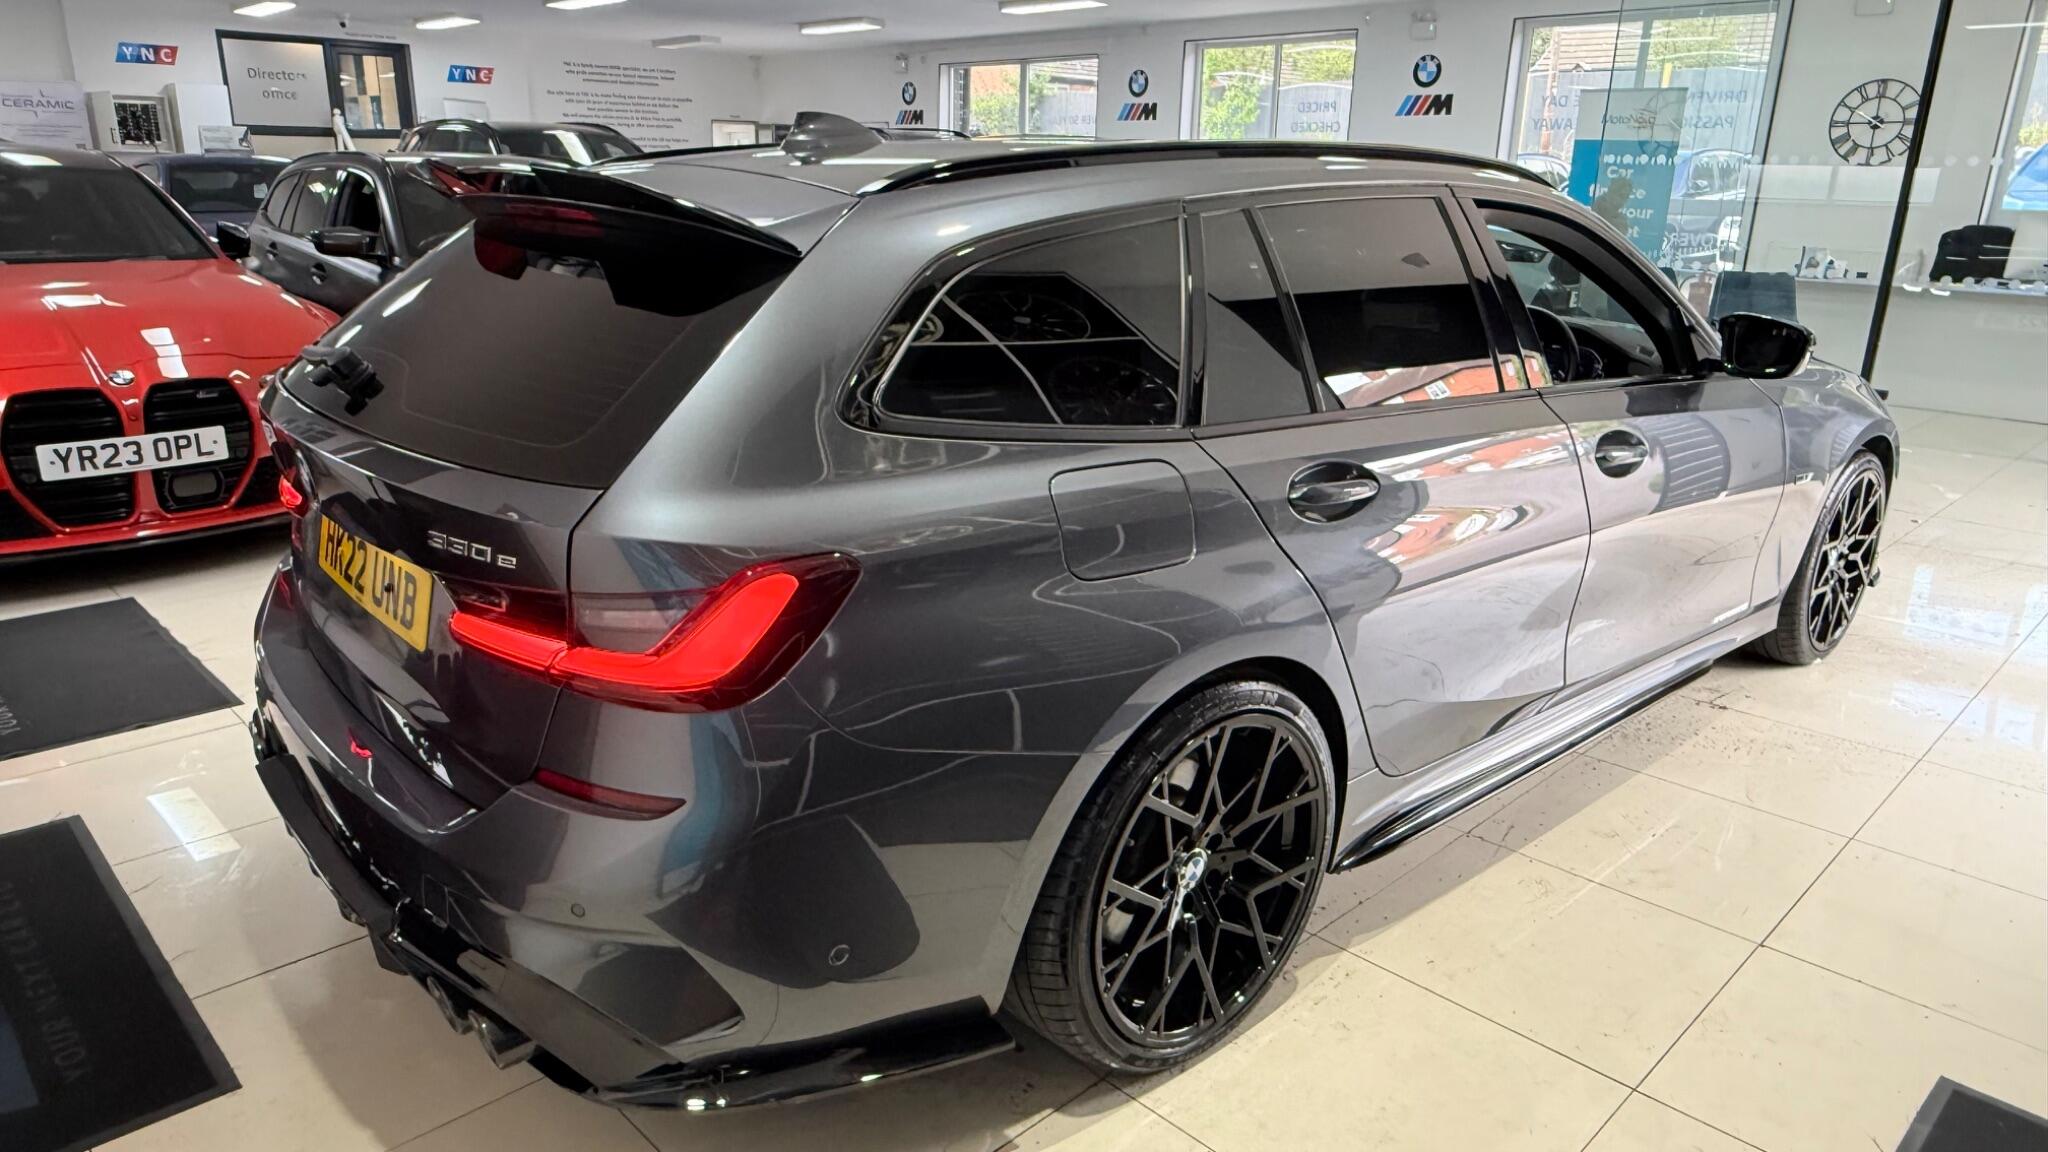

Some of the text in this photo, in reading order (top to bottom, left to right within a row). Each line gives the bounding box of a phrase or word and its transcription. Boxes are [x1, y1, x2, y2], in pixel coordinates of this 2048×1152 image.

[122, 46, 173, 63] YNC
[451, 68, 490, 82] YNC
[2, 98, 75, 110] CERAMIC
[52, 433, 215, 473] YR23 OPL
[325, 519, 417, 630] HK22 UNB
